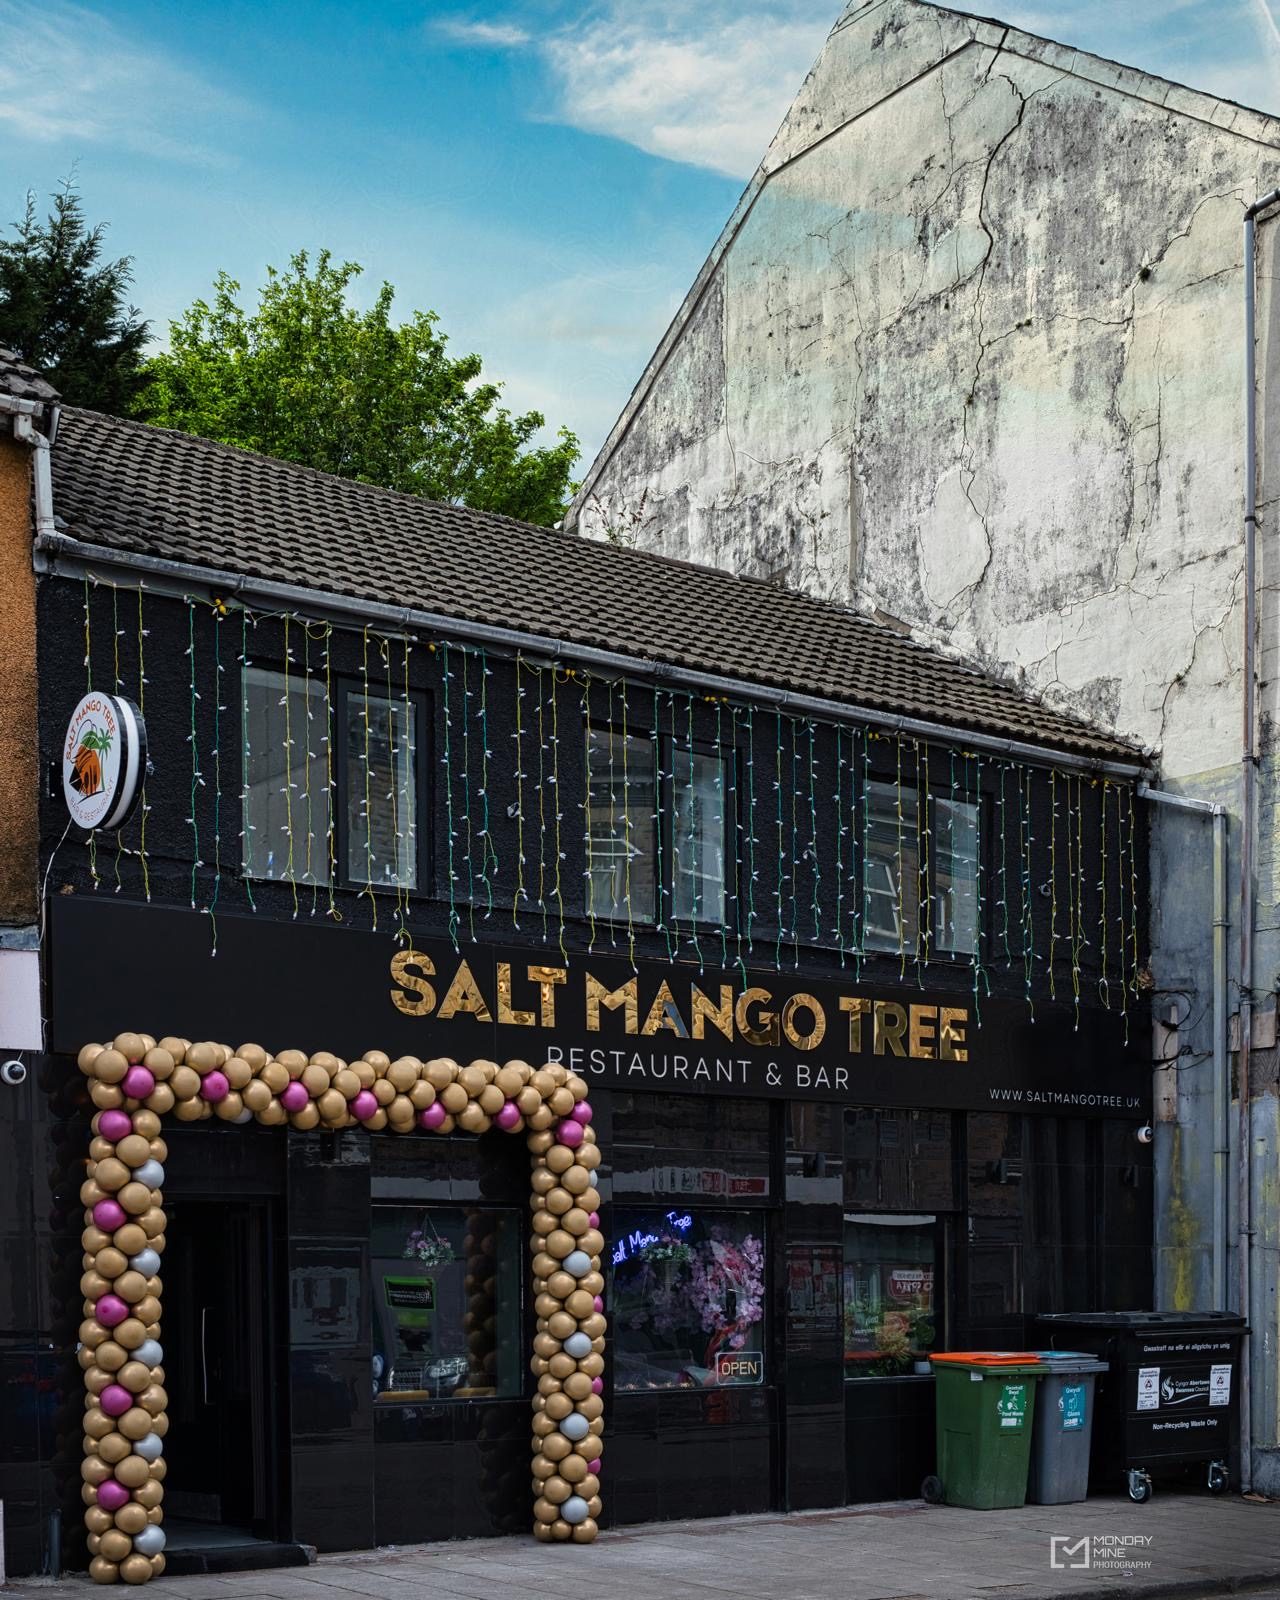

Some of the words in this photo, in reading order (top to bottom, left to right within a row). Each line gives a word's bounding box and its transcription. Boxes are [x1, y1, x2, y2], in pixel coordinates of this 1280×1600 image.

[66, 728, 76, 760] SALT
[75, 700, 101, 726] MANGO
[102, 705, 116, 735] TREE
[390, 950, 567, 1027] SALT
[585, 971, 826, 1050] MANGO
[839, 996, 968, 1062] TREE
[547, 1046, 752, 1083] RESTAURANT
[765, 1062, 782, 1086] &
[796, 1064, 849, 1090] BAR
[989, 1088, 1141, 1108] WWW.SALTMANGOTREE.UK
[721, 1361, 758, 1375] OPEN
[1152, 1421, 1190, 1431] Non-Recycling
[1206, 1418, 1218, 1427] Only
